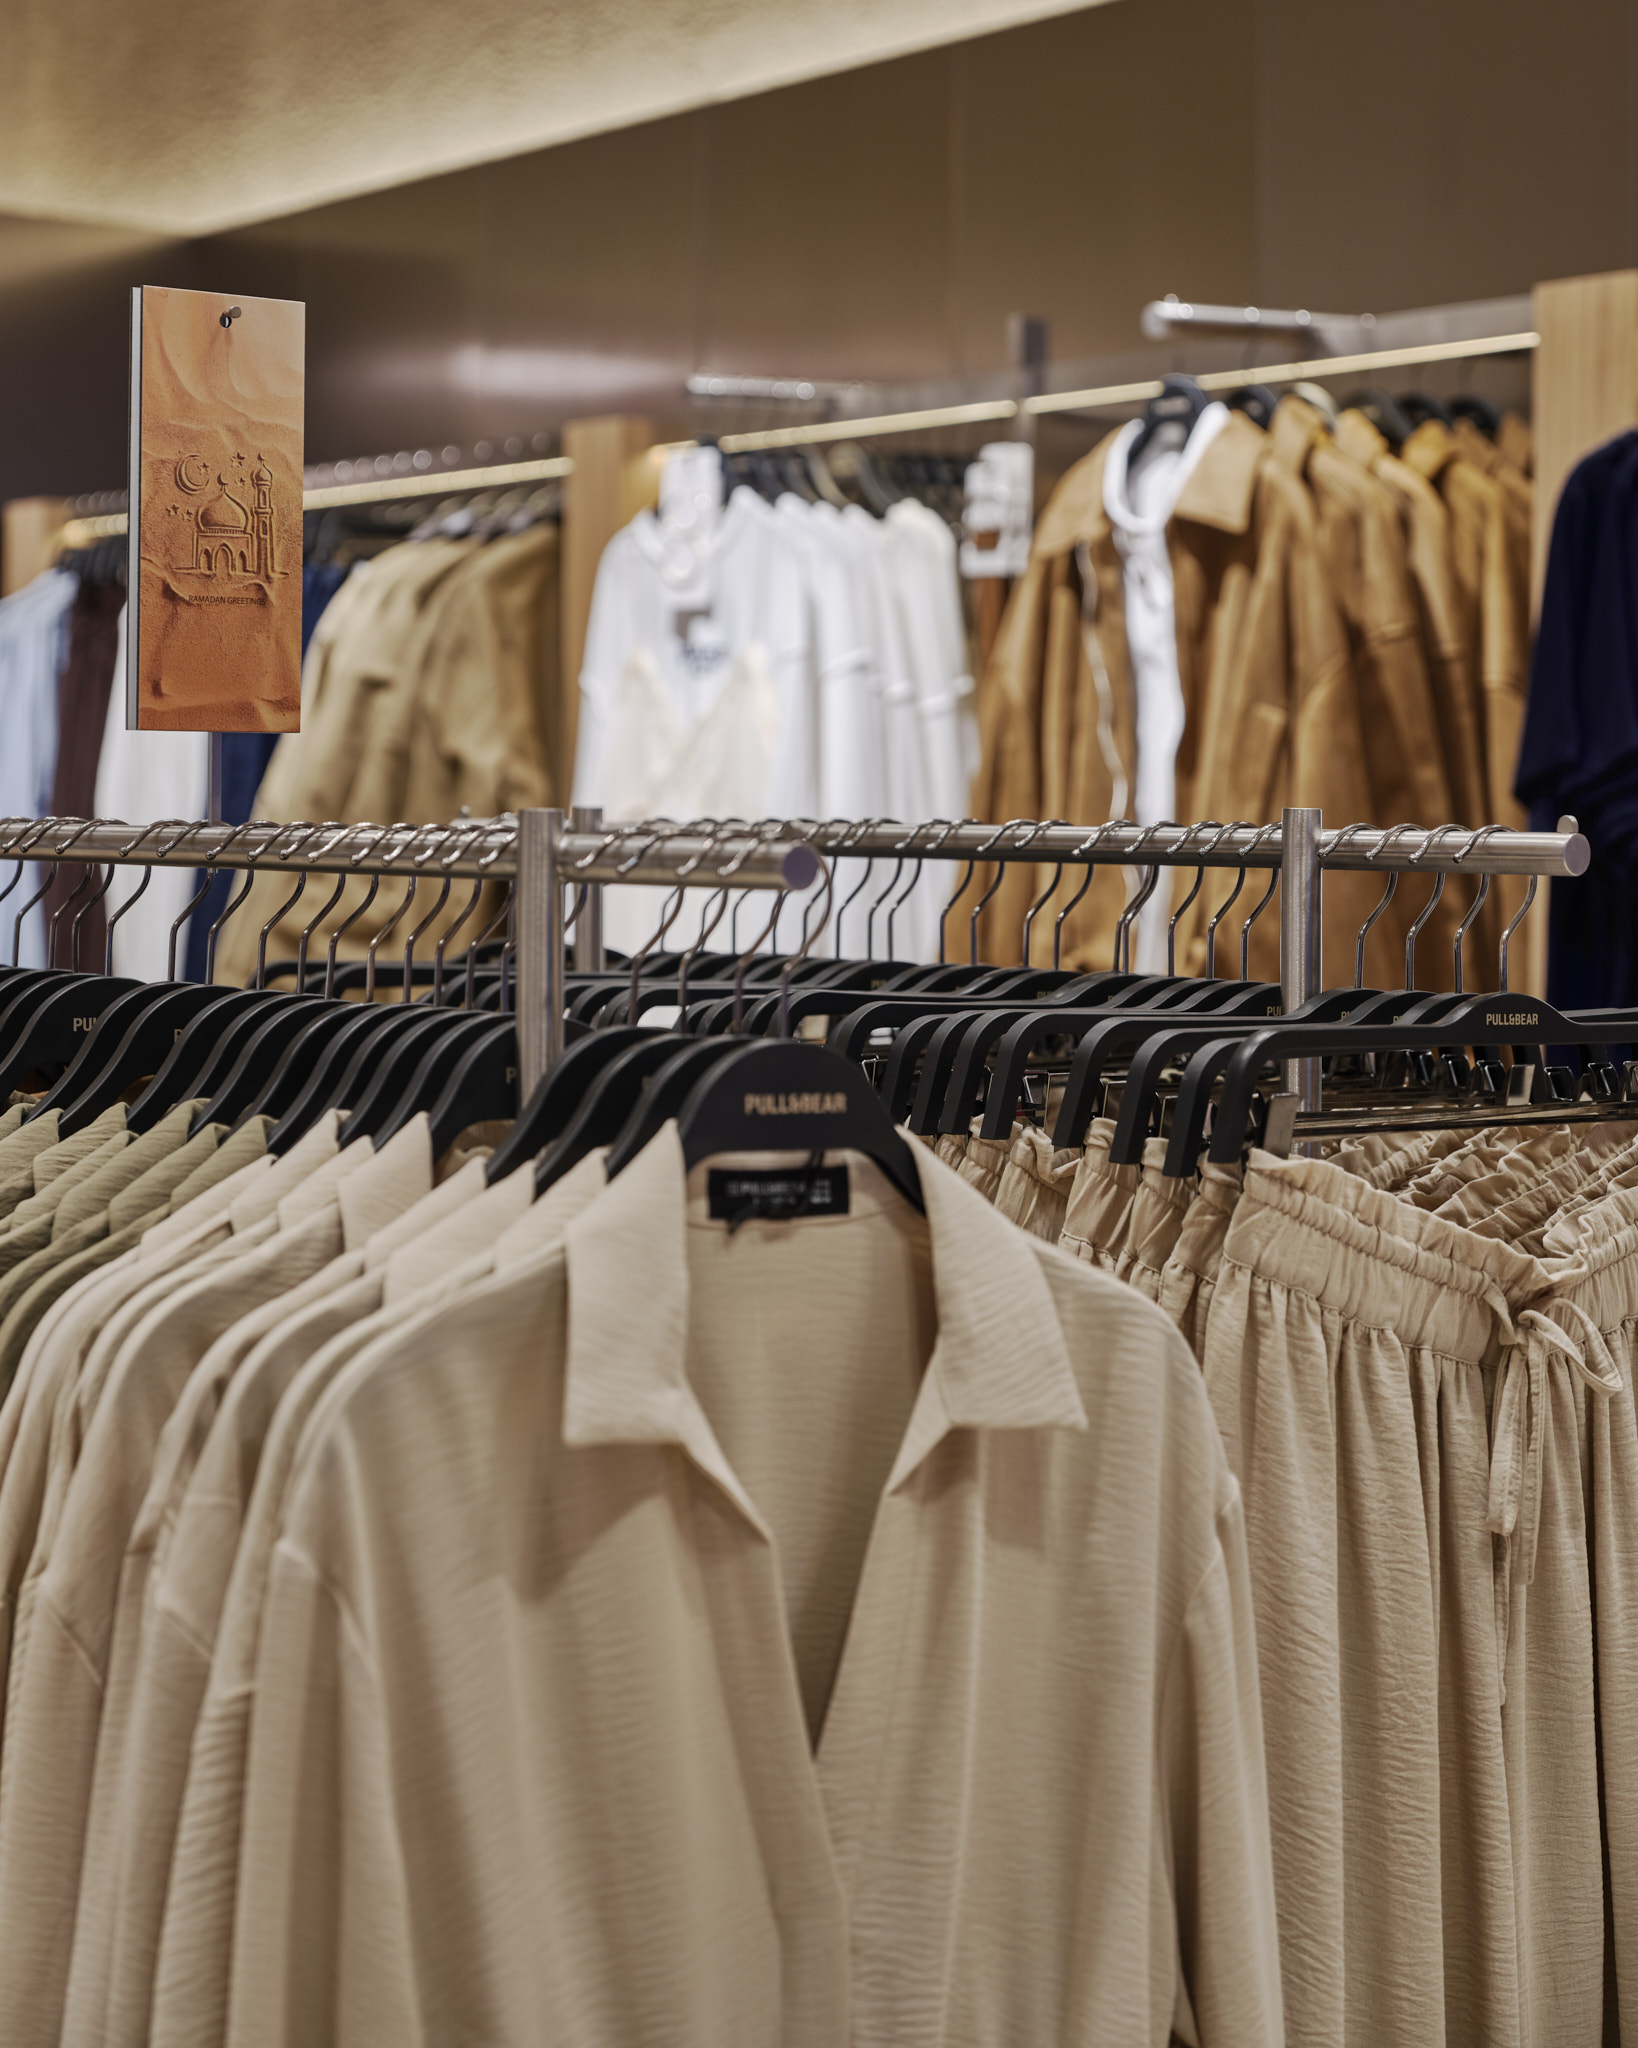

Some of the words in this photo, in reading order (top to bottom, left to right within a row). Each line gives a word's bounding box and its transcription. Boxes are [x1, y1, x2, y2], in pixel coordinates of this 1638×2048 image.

[188, 594, 226, 604] RAMADAN
[226, 596, 266, 606] GREETINGS
[1486, 1013, 1539, 1026] PULL&BEAR
[744, 1092, 847, 1115] PULL&BEAR
